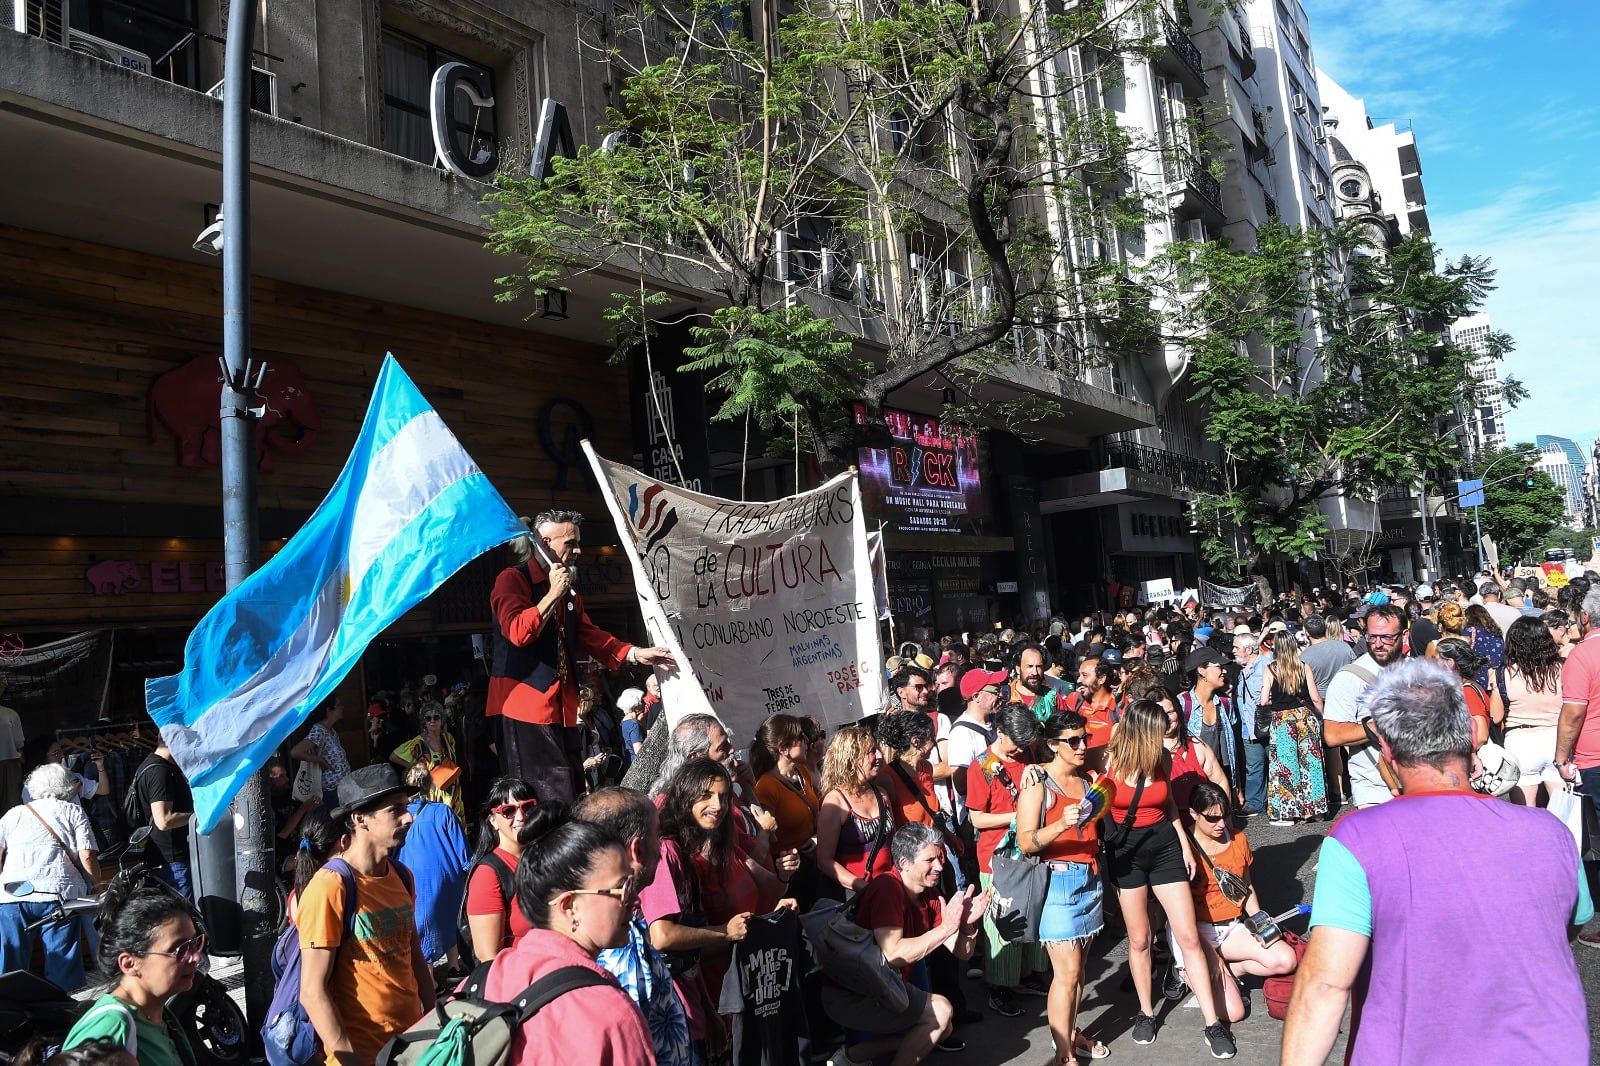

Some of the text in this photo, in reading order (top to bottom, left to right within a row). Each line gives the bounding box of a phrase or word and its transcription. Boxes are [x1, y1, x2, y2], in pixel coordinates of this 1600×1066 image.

[123, 56, 146, 73] BGH
[651, 443, 684, 466] CASA
[694, 548, 718, 576] de
[697, 539, 842, 608] LA CULTURA
[693, 617, 774, 649] CONURBANO
[783, 602, 866, 634] NOROESTE
[827, 661, 857, 683] JOSÉ
[762, 684, 795, 701] TRES DE
[837, 678, 864, 695] PAZ
[765, 694, 801, 714] FEBRERO
